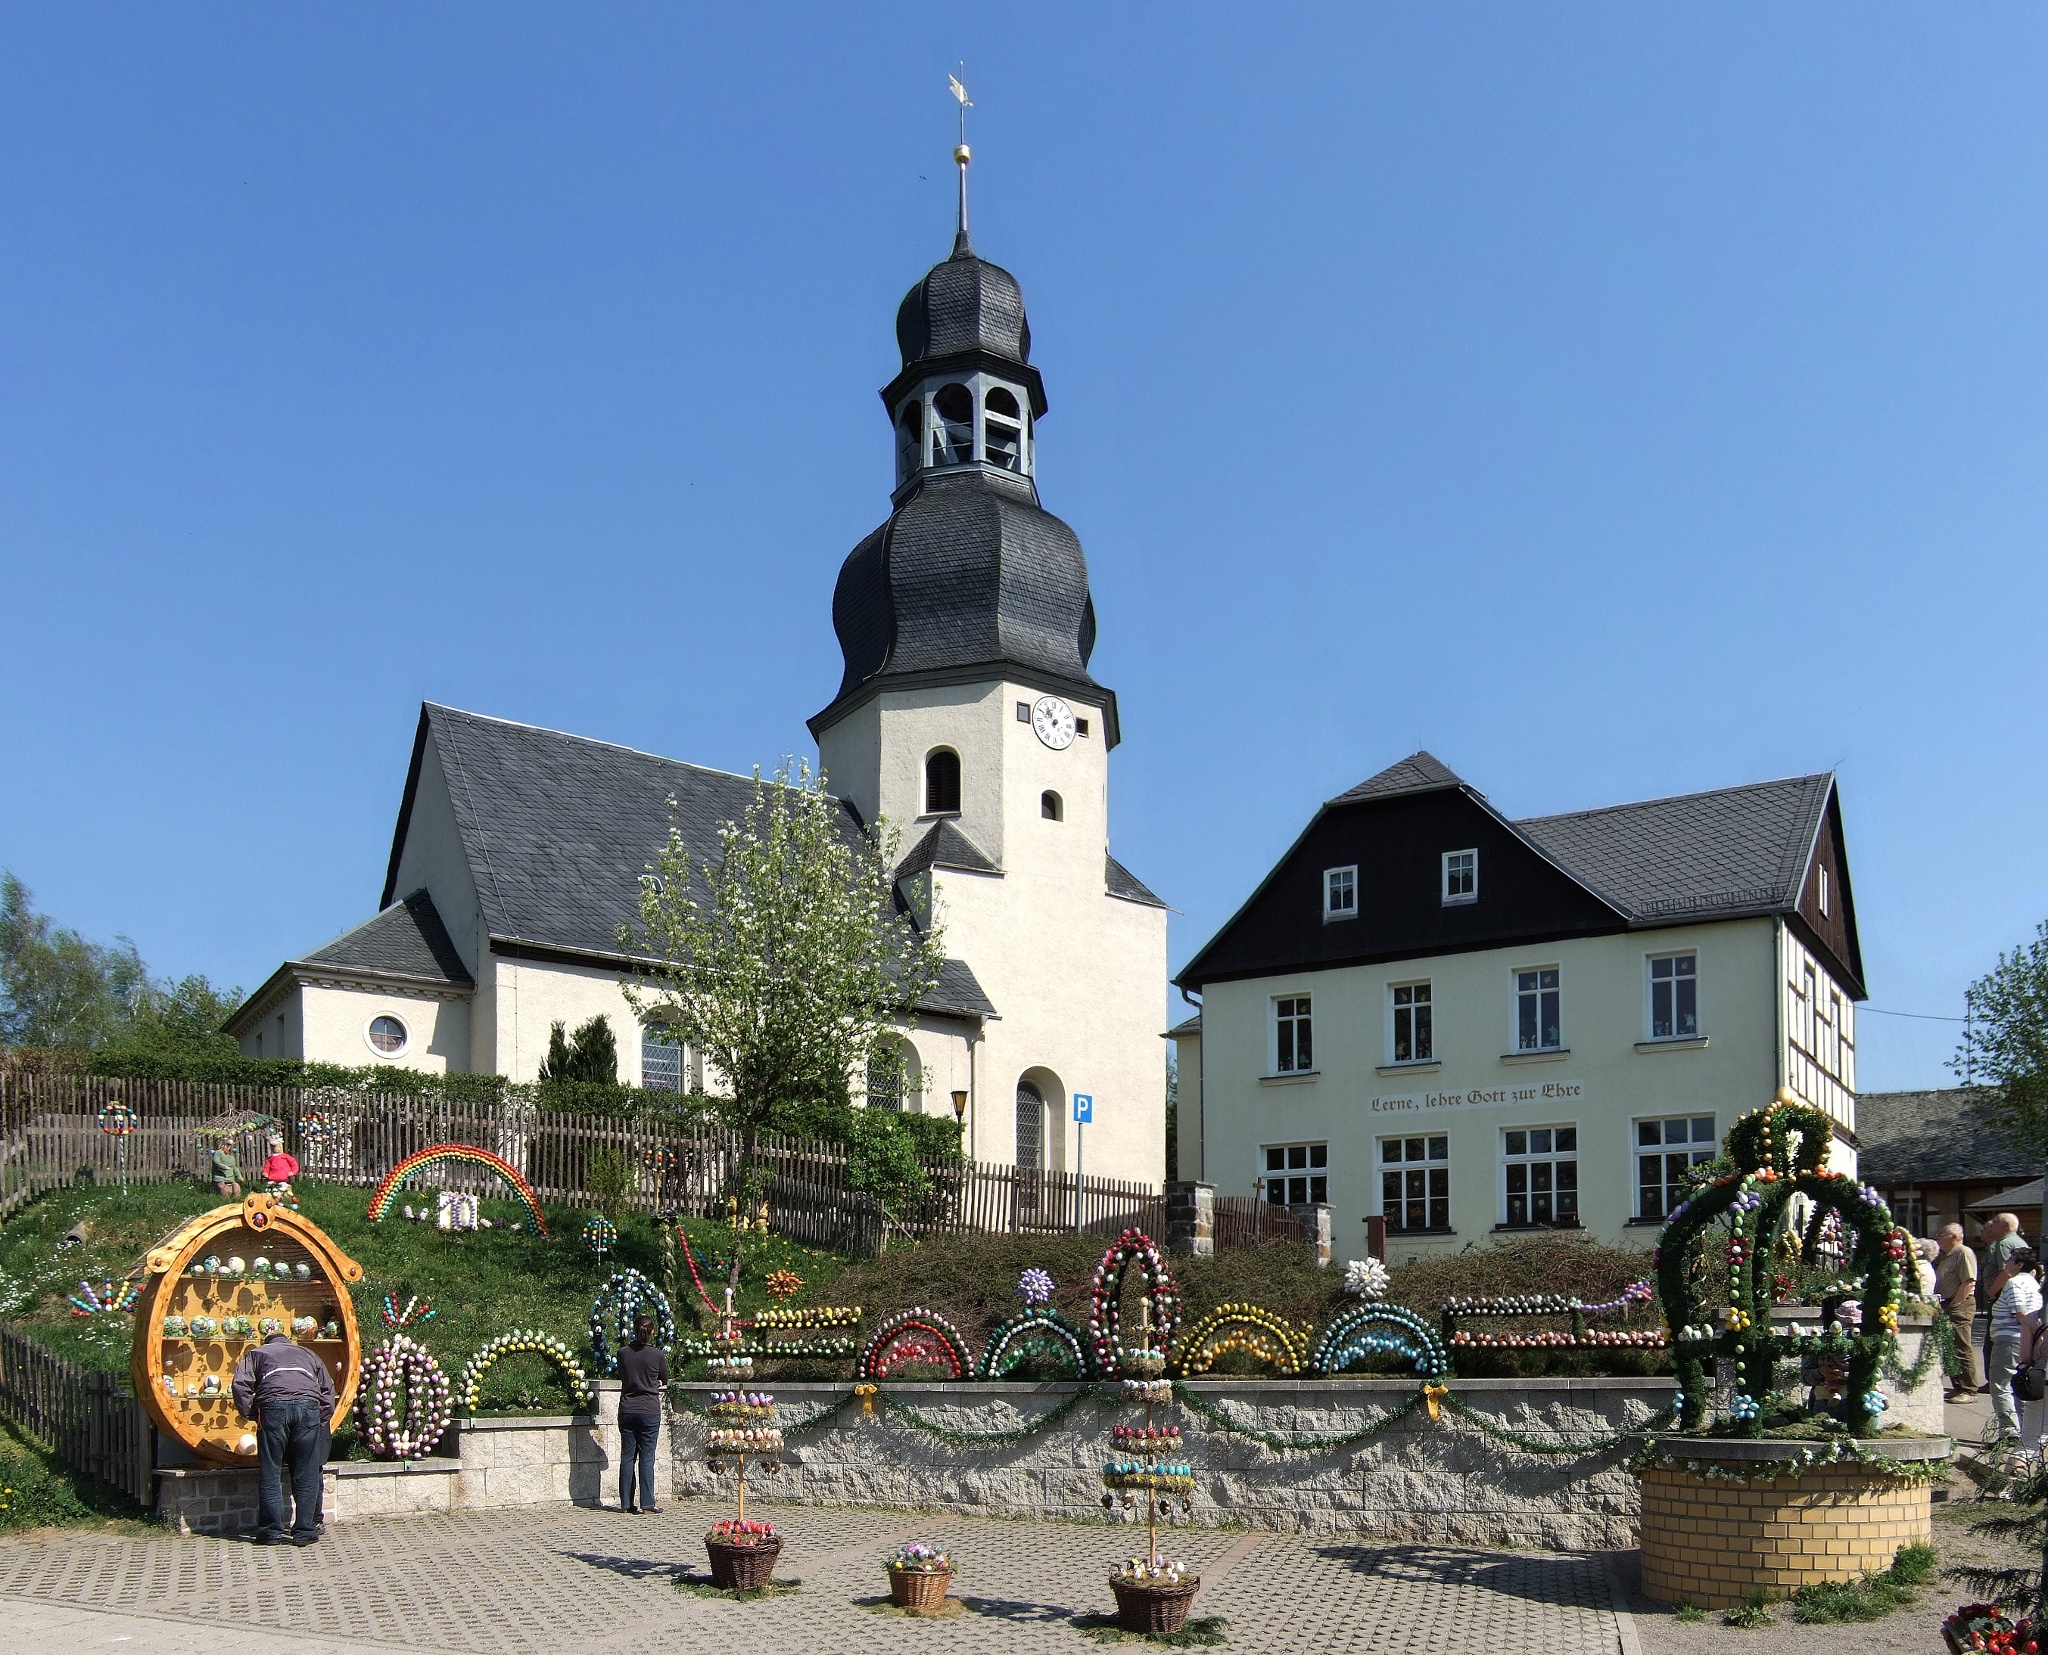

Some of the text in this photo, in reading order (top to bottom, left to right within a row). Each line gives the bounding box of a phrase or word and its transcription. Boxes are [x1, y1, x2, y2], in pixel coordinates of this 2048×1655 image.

[1077, 1097, 1089, 1119] P
[1371, 1083, 1581, 1112] Lerne, lehre Gott zur Ehre
